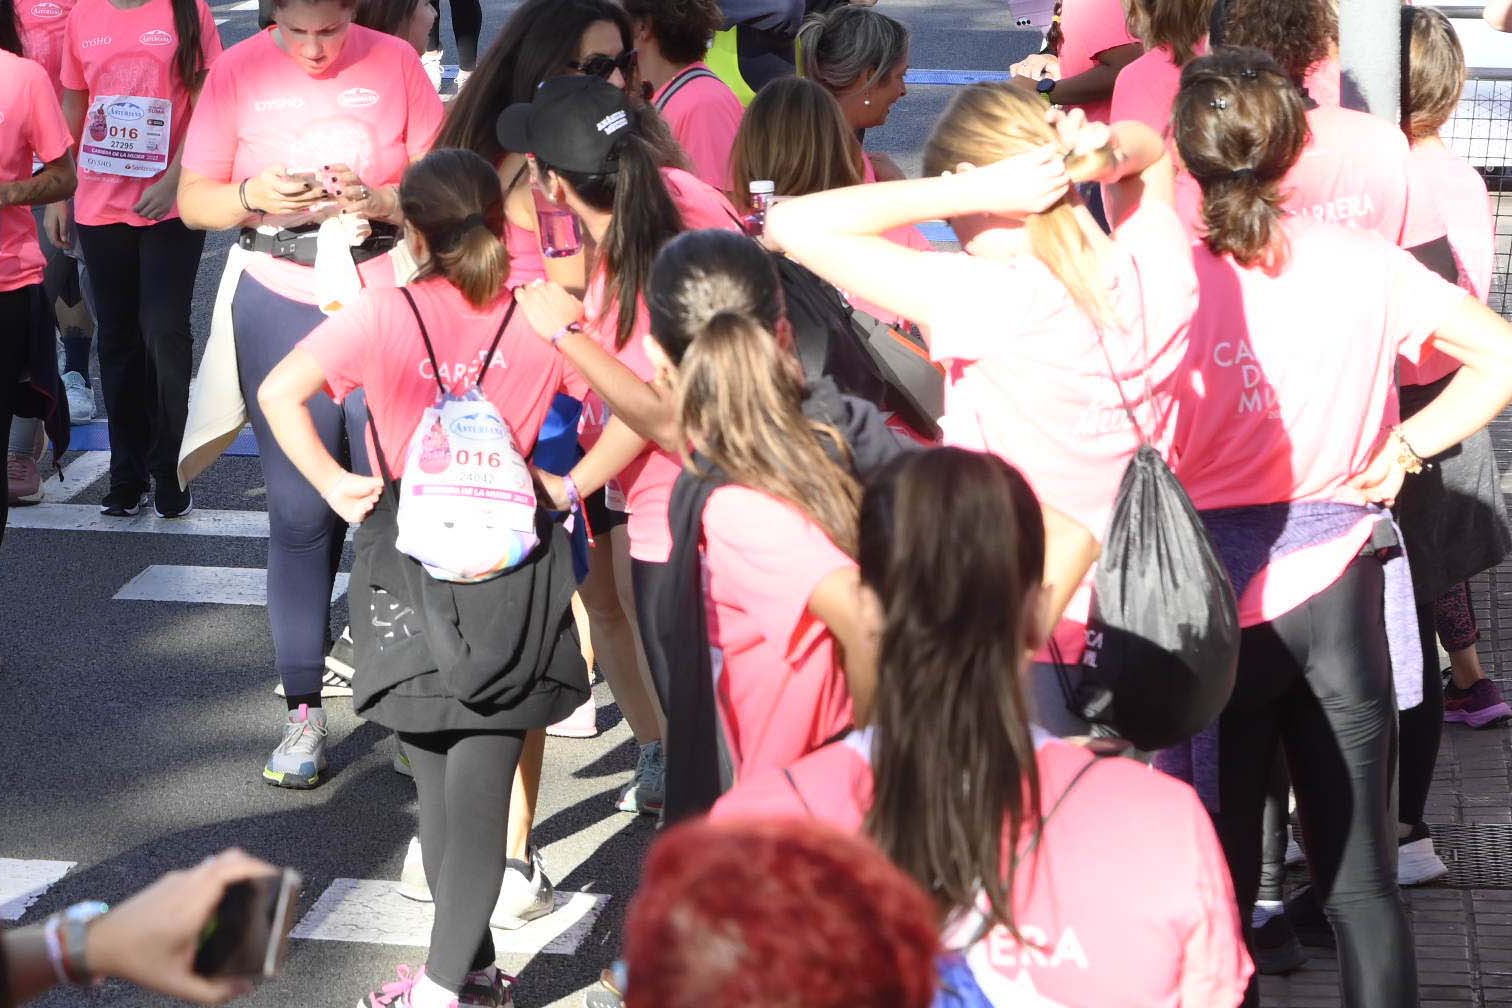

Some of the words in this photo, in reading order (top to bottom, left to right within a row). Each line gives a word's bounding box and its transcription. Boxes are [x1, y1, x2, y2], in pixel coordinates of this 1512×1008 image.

[109, 125, 138, 140] 016
[110, 140, 134, 150] 27295
[455, 449, 501, 468] 016
